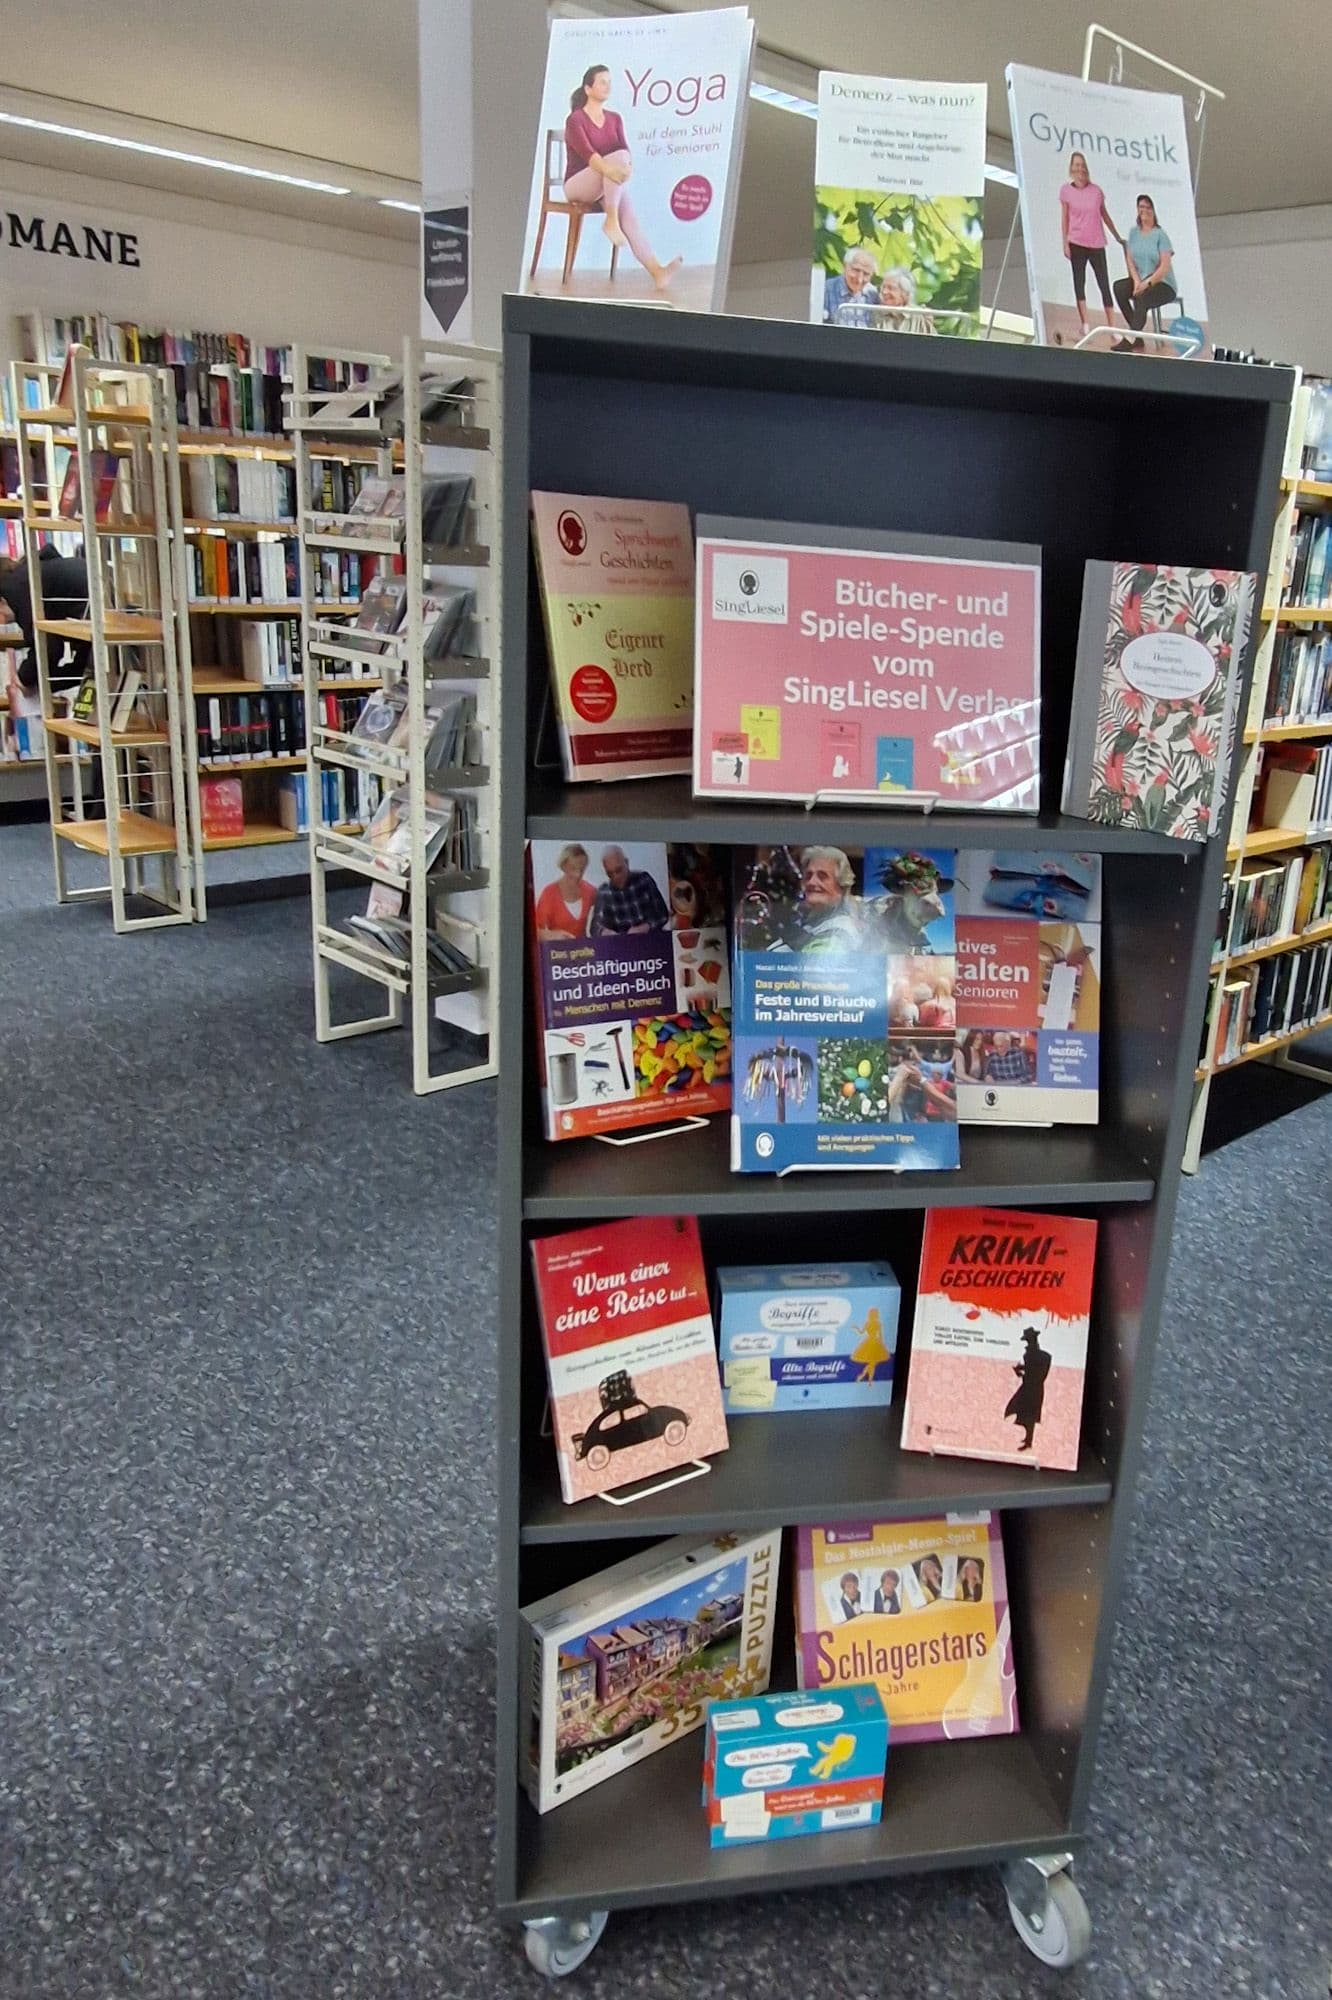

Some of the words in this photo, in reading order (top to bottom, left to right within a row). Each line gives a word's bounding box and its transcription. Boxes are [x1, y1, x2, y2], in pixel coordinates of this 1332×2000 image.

[624, 67, 727, 117] Yoga
[831, 84, 893, 103] Demenz
[908, 94, 936, 106] was
[939, 95, 976, 107] nun?
[638, 125, 659, 141] auf
[660, 126, 688, 140] dem
[691, 123, 723, 138] Stuhl
[1029, 112, 1178, 164] Gymnastik
[645, 142, 664, 157] für
[667, 141, 721, 155] Senioren
[0, 212, 140, 267] MANE
[715, 599, 786, 617] SingLiesel
[835, 578, 947, 612] Bücher-
[956, 592, 1008, 617] und
[605, 628, 665, 652] Eigener
[800, 610, 1004, 650] Spiele-Spende
[872, 656, 934, 678] vom
[783, 677, 927, 712] SingLiesel
[551, 949, 568, 960] Das
[552, 958, 668, 981] Beschäftigungs-
[553, 985, 582, 1002] und
[587, 976, 671, 999] Ideen-Buch
[755, 979, 773, 990] Das
[953, 983, 1019, 1000] Senioren
[628, 996, 662, 1009] Demenz
[755, 994, 792, 1007] Feste
[795, 995, 820, 1007] und
[822, 995, 877, 1009] Bräuche
[755, 1009, 773, 1021] im
[775, 1009, 865, 1023] Jahresverlauf
[949, 1234, 1068, 1266] KRIMI-
[572, 1272, 628, 1297] Wenn
[630, 1261, 671, 1283] einer
[940, 1269, 1066, 1290] GESCHICHTEN
[555, 1305, 601, 1332] eine
[606, 1287, 669, 1319] Reise
[670, 1285, 687, 1301] tut
[747, 1545, 772, 1653] PUZZLE
[816, 1630, 987, 1684] Schlagerstars
[881, 1681, 919, 1696] Jahre
